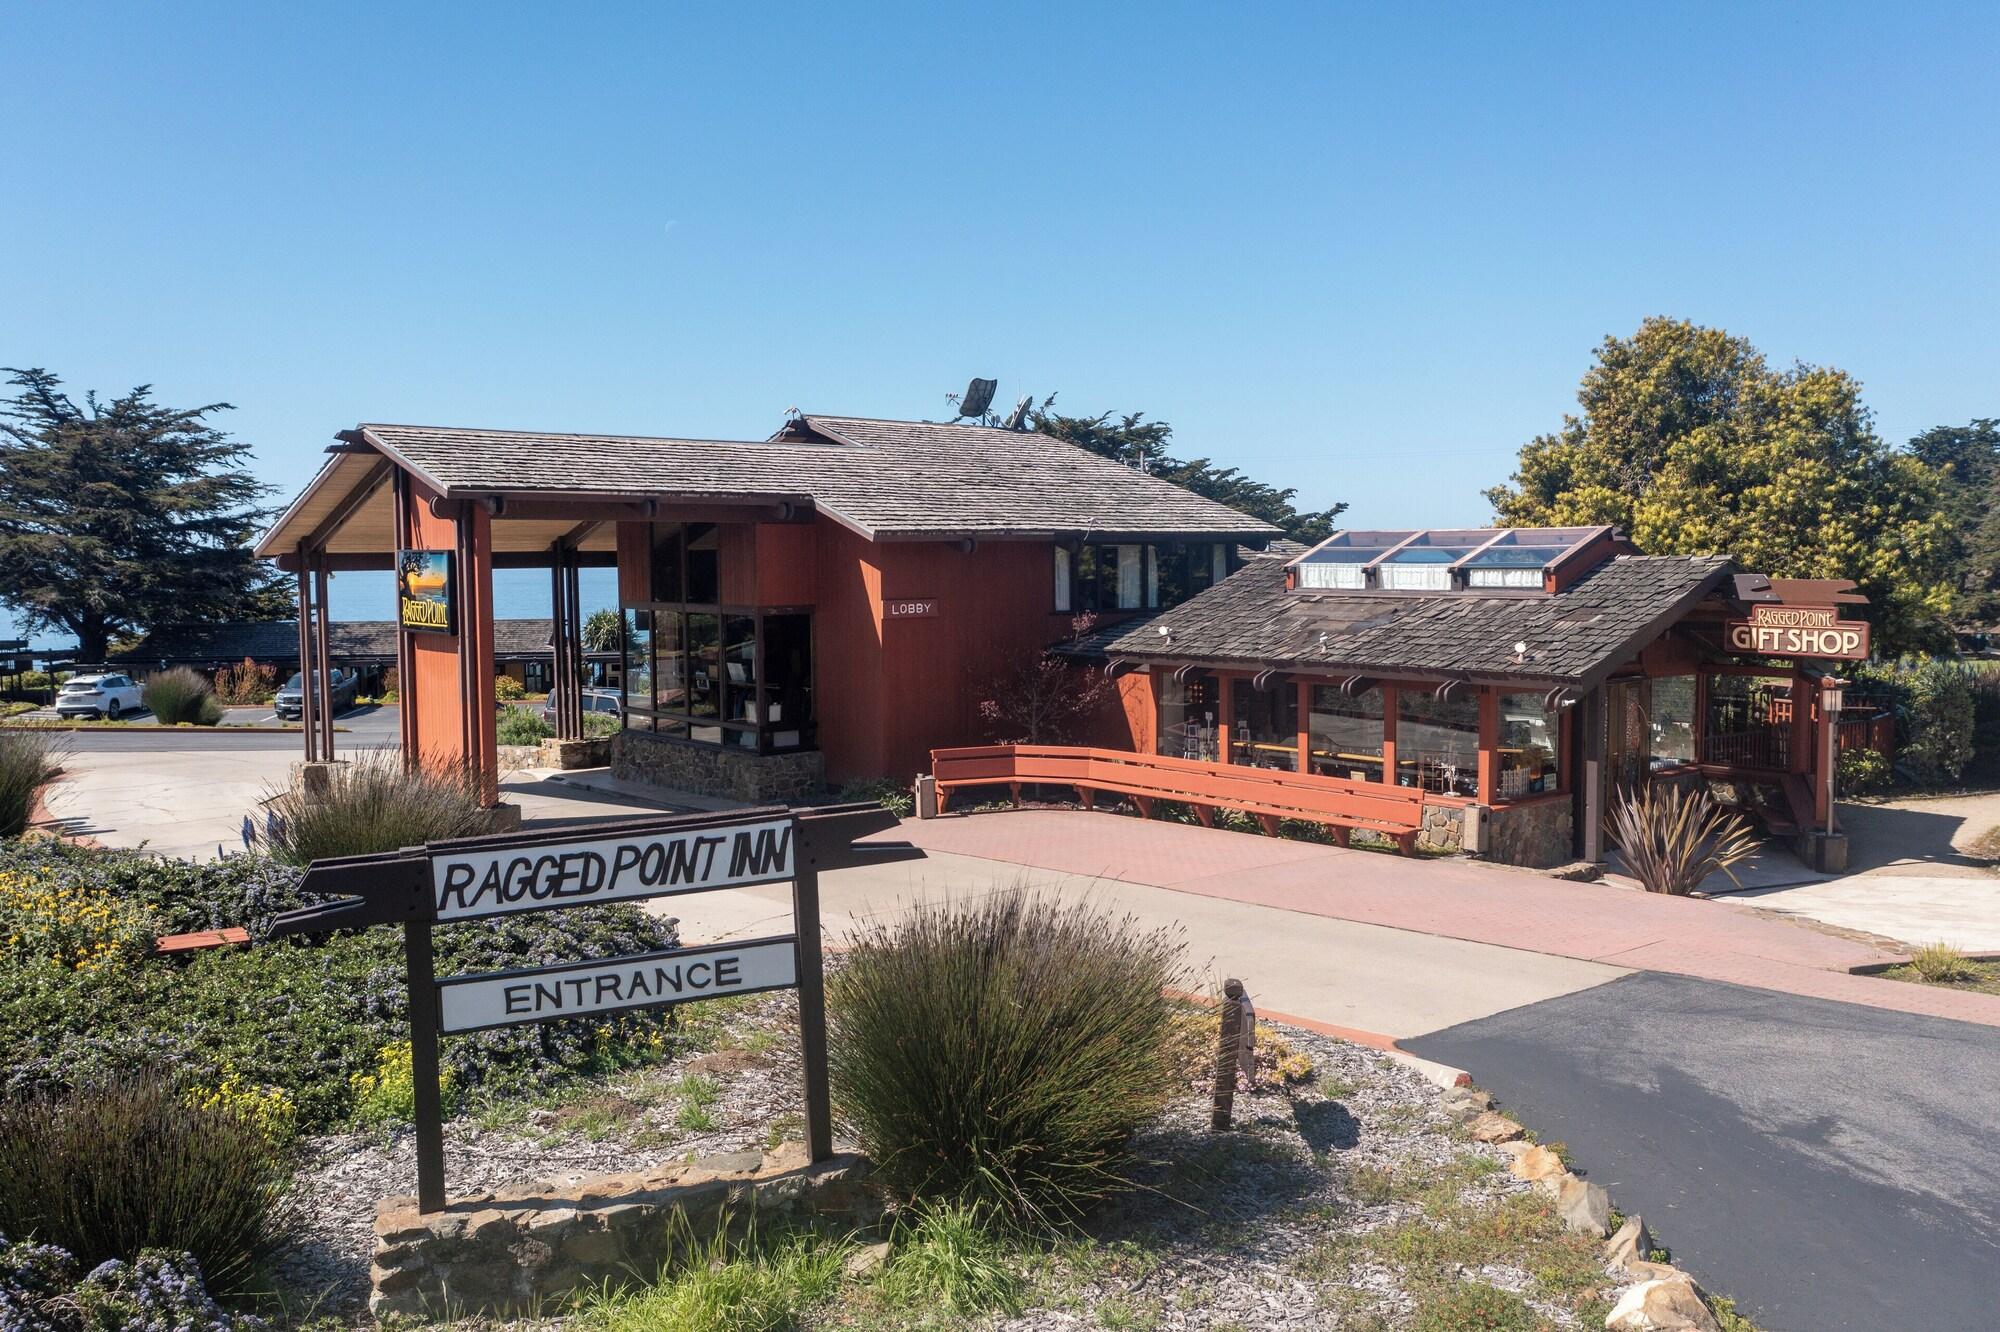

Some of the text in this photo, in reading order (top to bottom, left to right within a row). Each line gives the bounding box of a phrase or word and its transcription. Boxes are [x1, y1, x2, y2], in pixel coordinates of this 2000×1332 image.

[891, 603, 931, 615] LOBBY
[1757, 608, 1800, 627] RAGGED
[1732, 626, 1859, 655] GIFT SHOP
[437, 826, 792, 911] RAGGED POINT INN
[504, 957, 742, 1014] ENTRANCE
